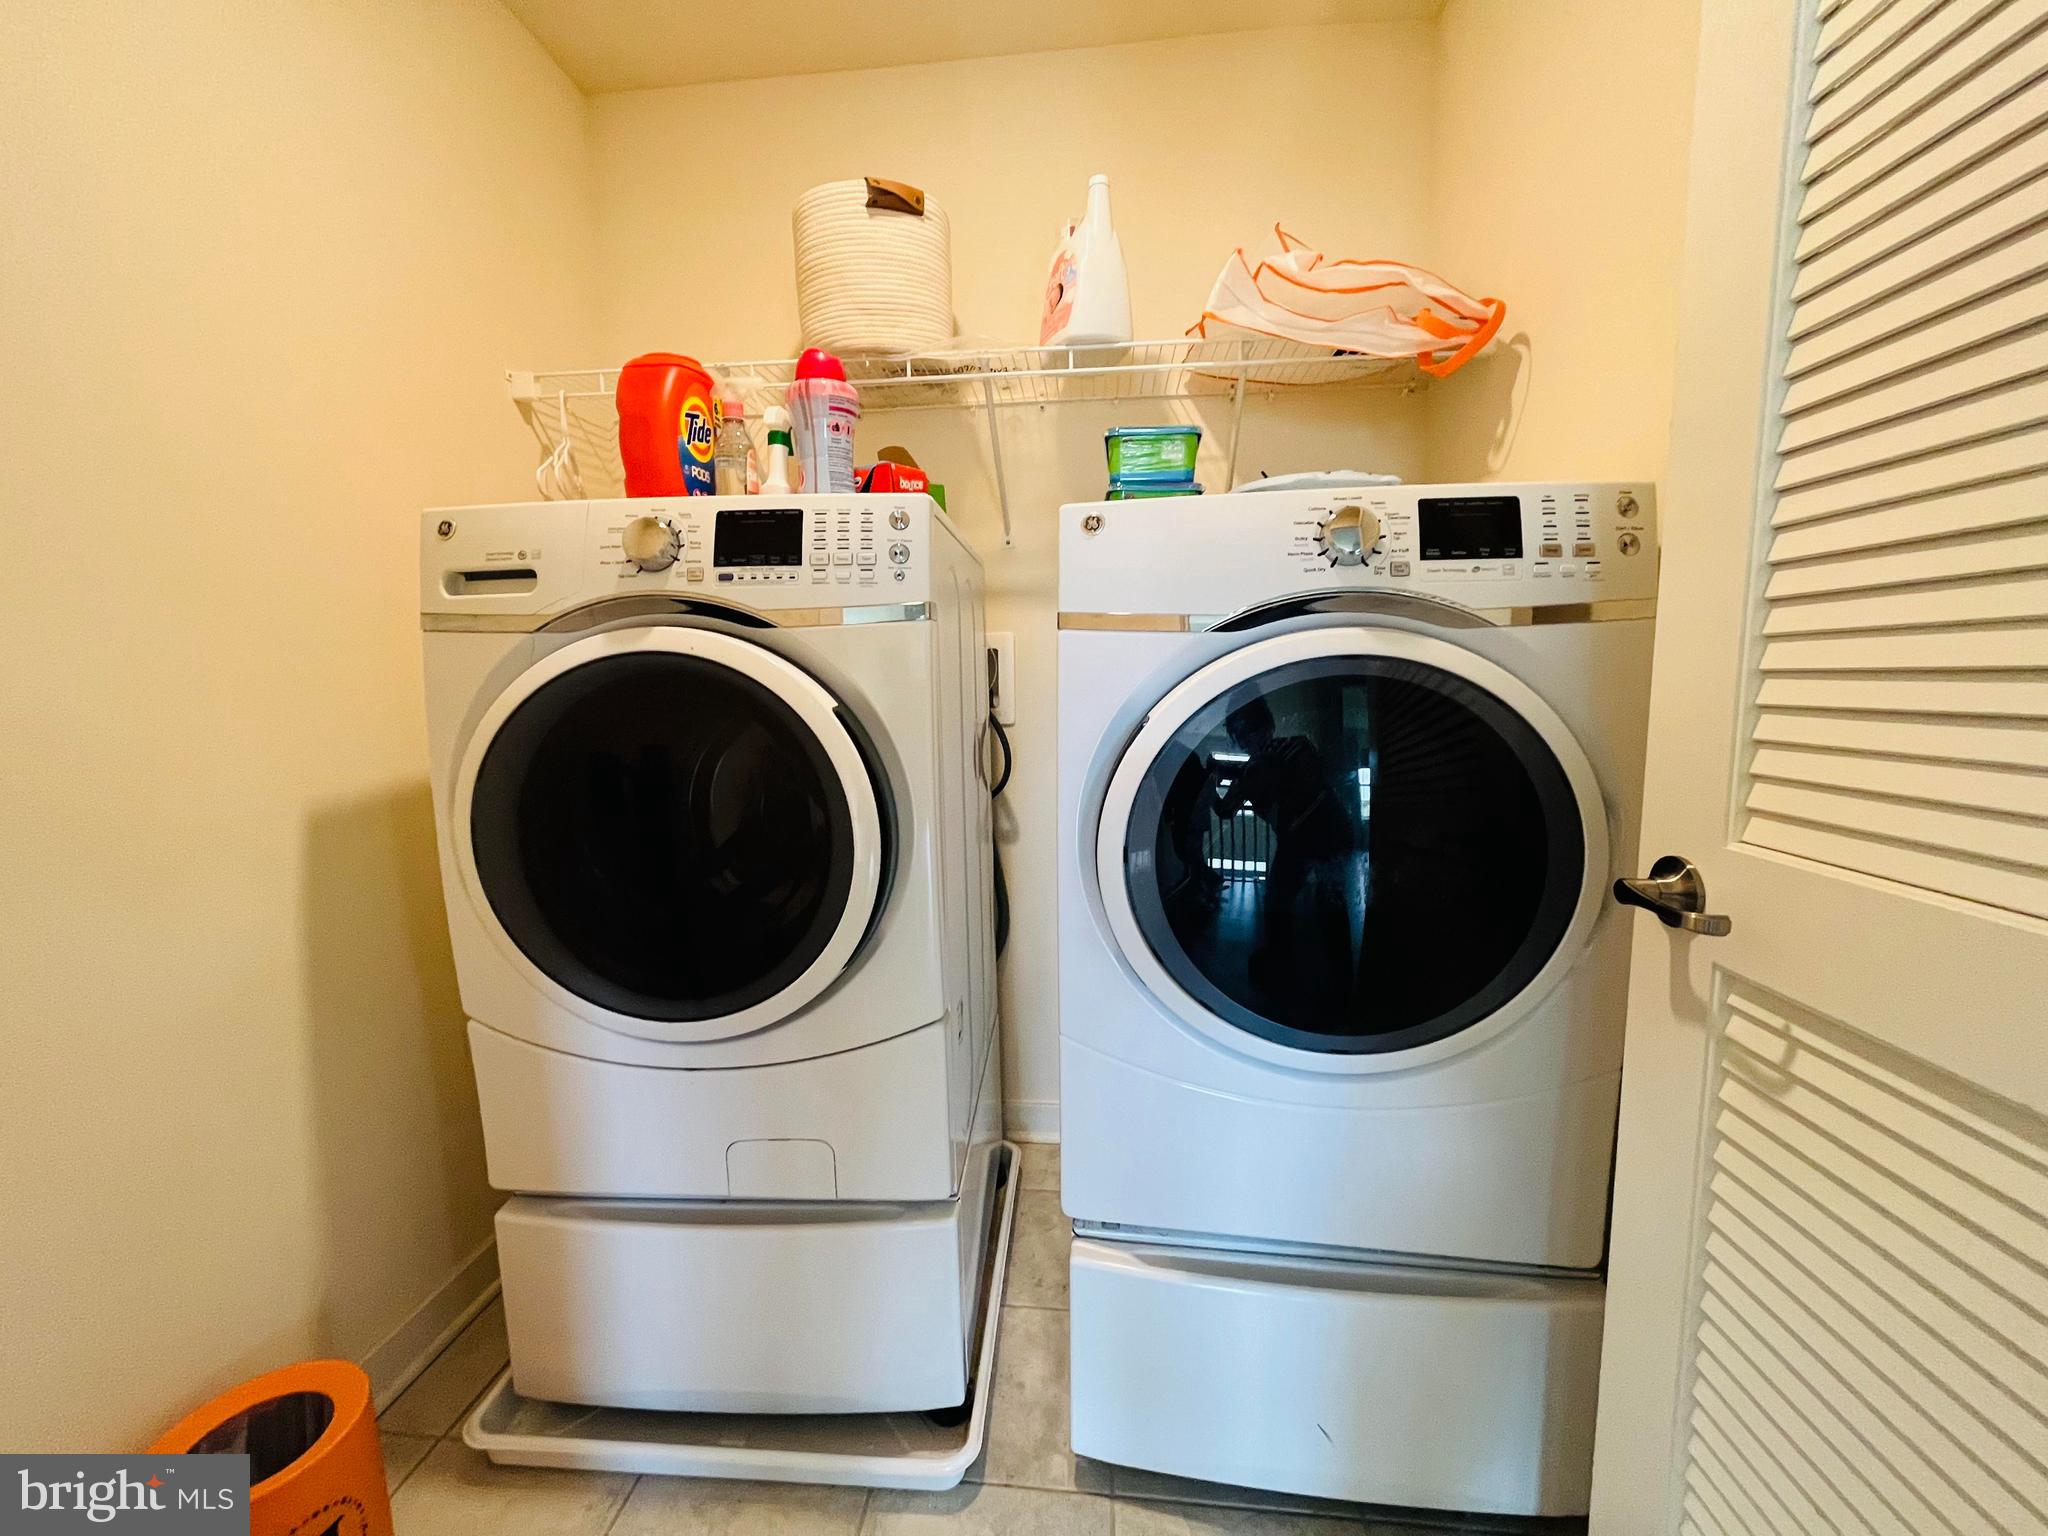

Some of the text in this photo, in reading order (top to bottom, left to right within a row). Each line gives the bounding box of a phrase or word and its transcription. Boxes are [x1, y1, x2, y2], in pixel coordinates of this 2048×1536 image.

[685, 412, 712, 446] Tide
[691, 465, 711, 484] PODS
[899, 475, 924, 491] bounce
